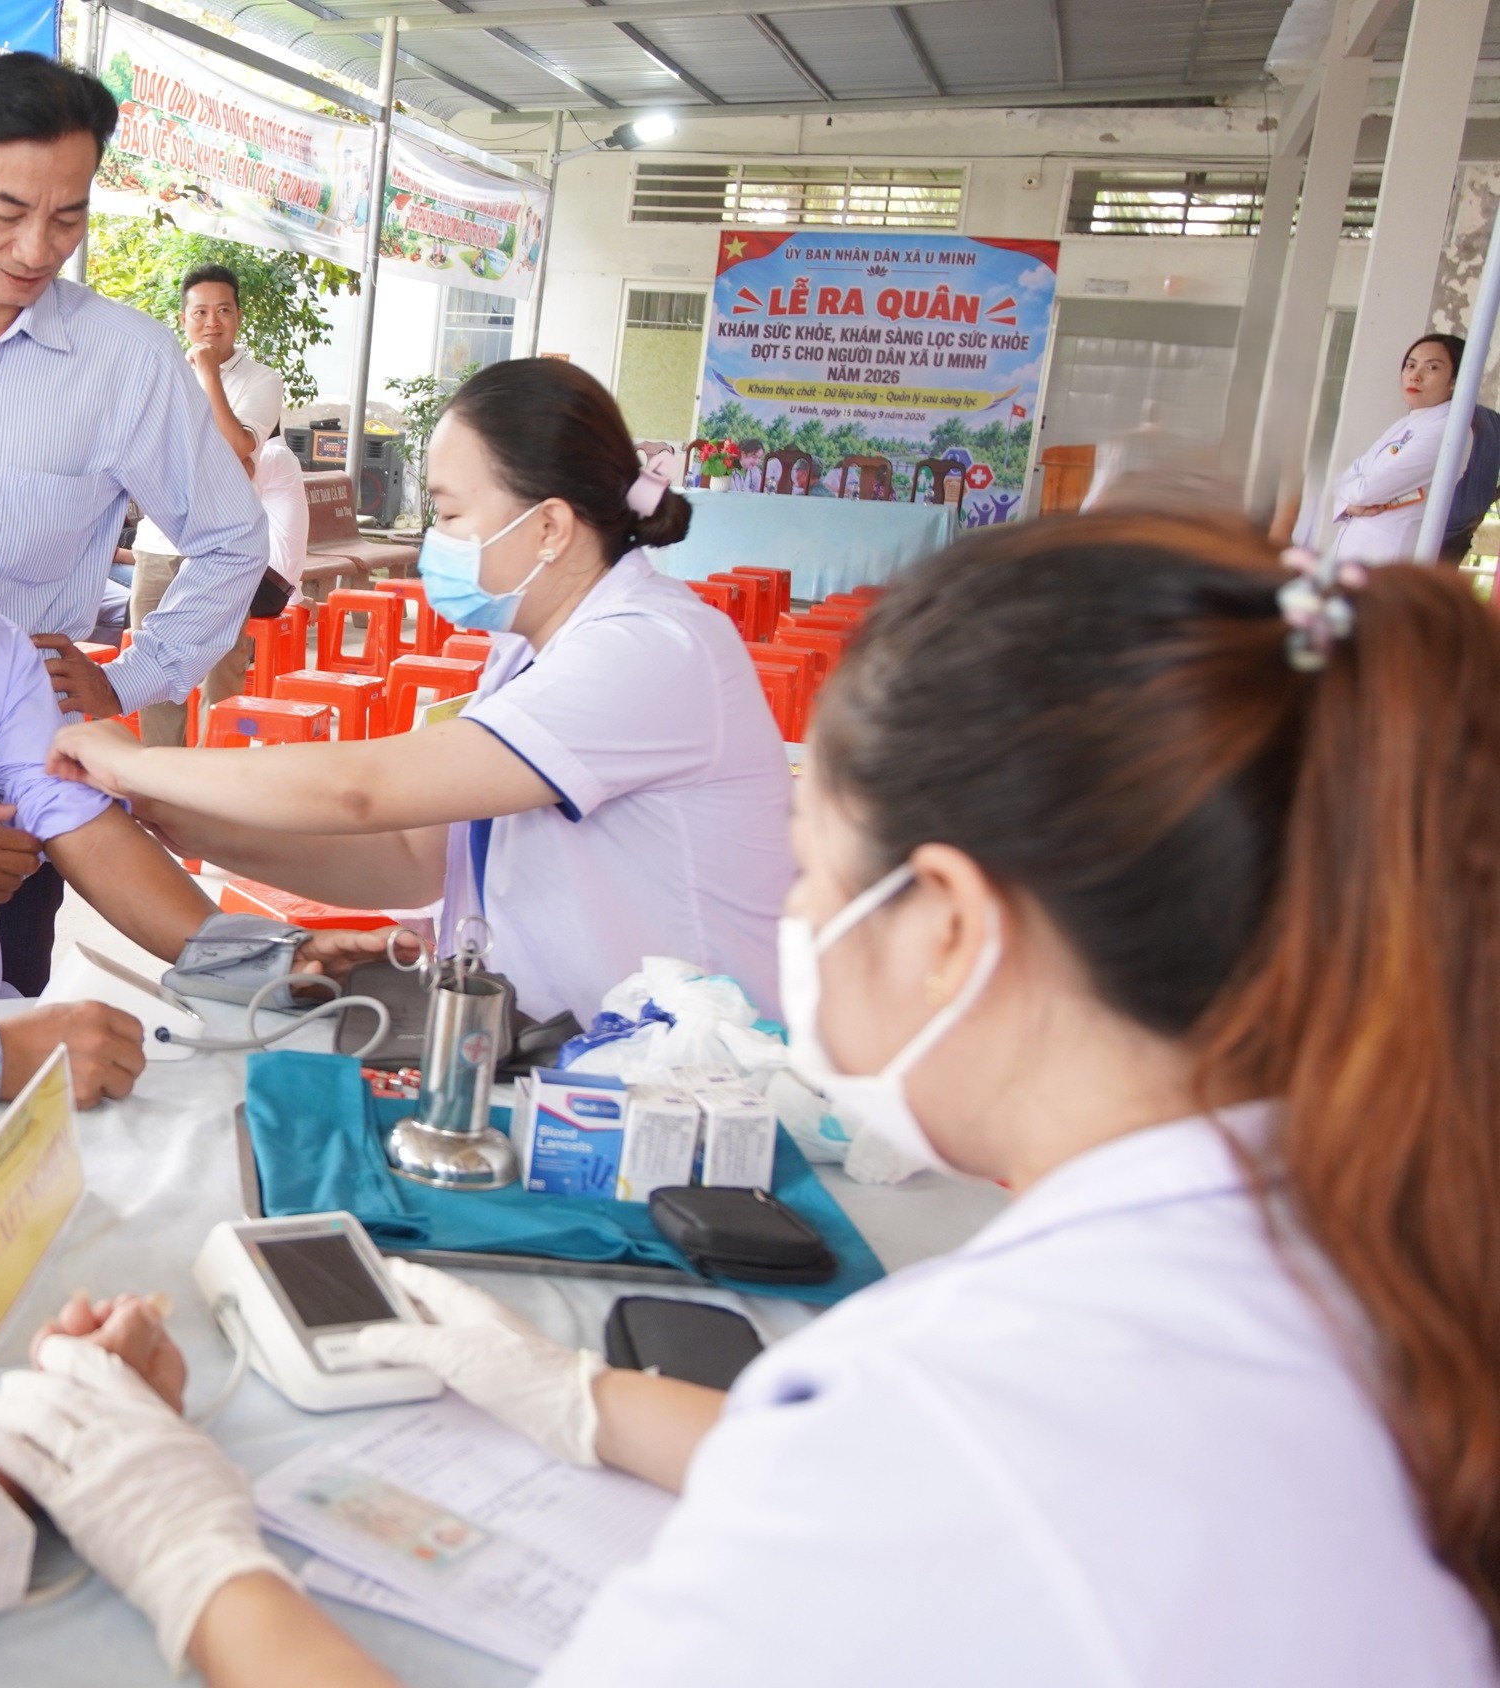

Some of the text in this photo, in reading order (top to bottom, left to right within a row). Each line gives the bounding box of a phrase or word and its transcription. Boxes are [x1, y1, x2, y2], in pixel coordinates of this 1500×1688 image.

[132, 64, 170, 108] TOÀN
[168, 78, 197, 119] DÂN
[120, 106, 149, 156] BẢO
[785, 245, 977, 266] ỦY BAN NHÂN DÂN XÃ U MINH
[768, 277, 981, 325] LỄ RA QUÂN
[717, 321, 1030, 350] KHÁM SỨC KHỎE, KHÁM SÀNG LỌC SỨC KHỎE
[750, 343, 988, 370] ĐỢT 5 CHO NGƯỜI DÂN XÃ U MINH
[826, 365, 901, 385] NĂM 2026
[747, 383, 774, 395] Khám
[775, 385, 794, 398] thực
[796, 384, 817, 397] chất
[823, 387, 839, 398] Dữ
[838, 388, 855, 401] liệu
[855, 388, 878, 401] sống
[886, 390, 911, 402] Quản
[912, 392, 921, 404] lý
[922, 394, 938, 404] sau
[939, 393, 962, 406] sàng
[963, 394, 978, 408] lọc
[821, 406, 841, 418] ngày
[853, 408, 877, 420] tháng
[877, 410, 884, 419] 9
[884, 411, 904, 420] năm
[904, 412, 926, 421] 2026
